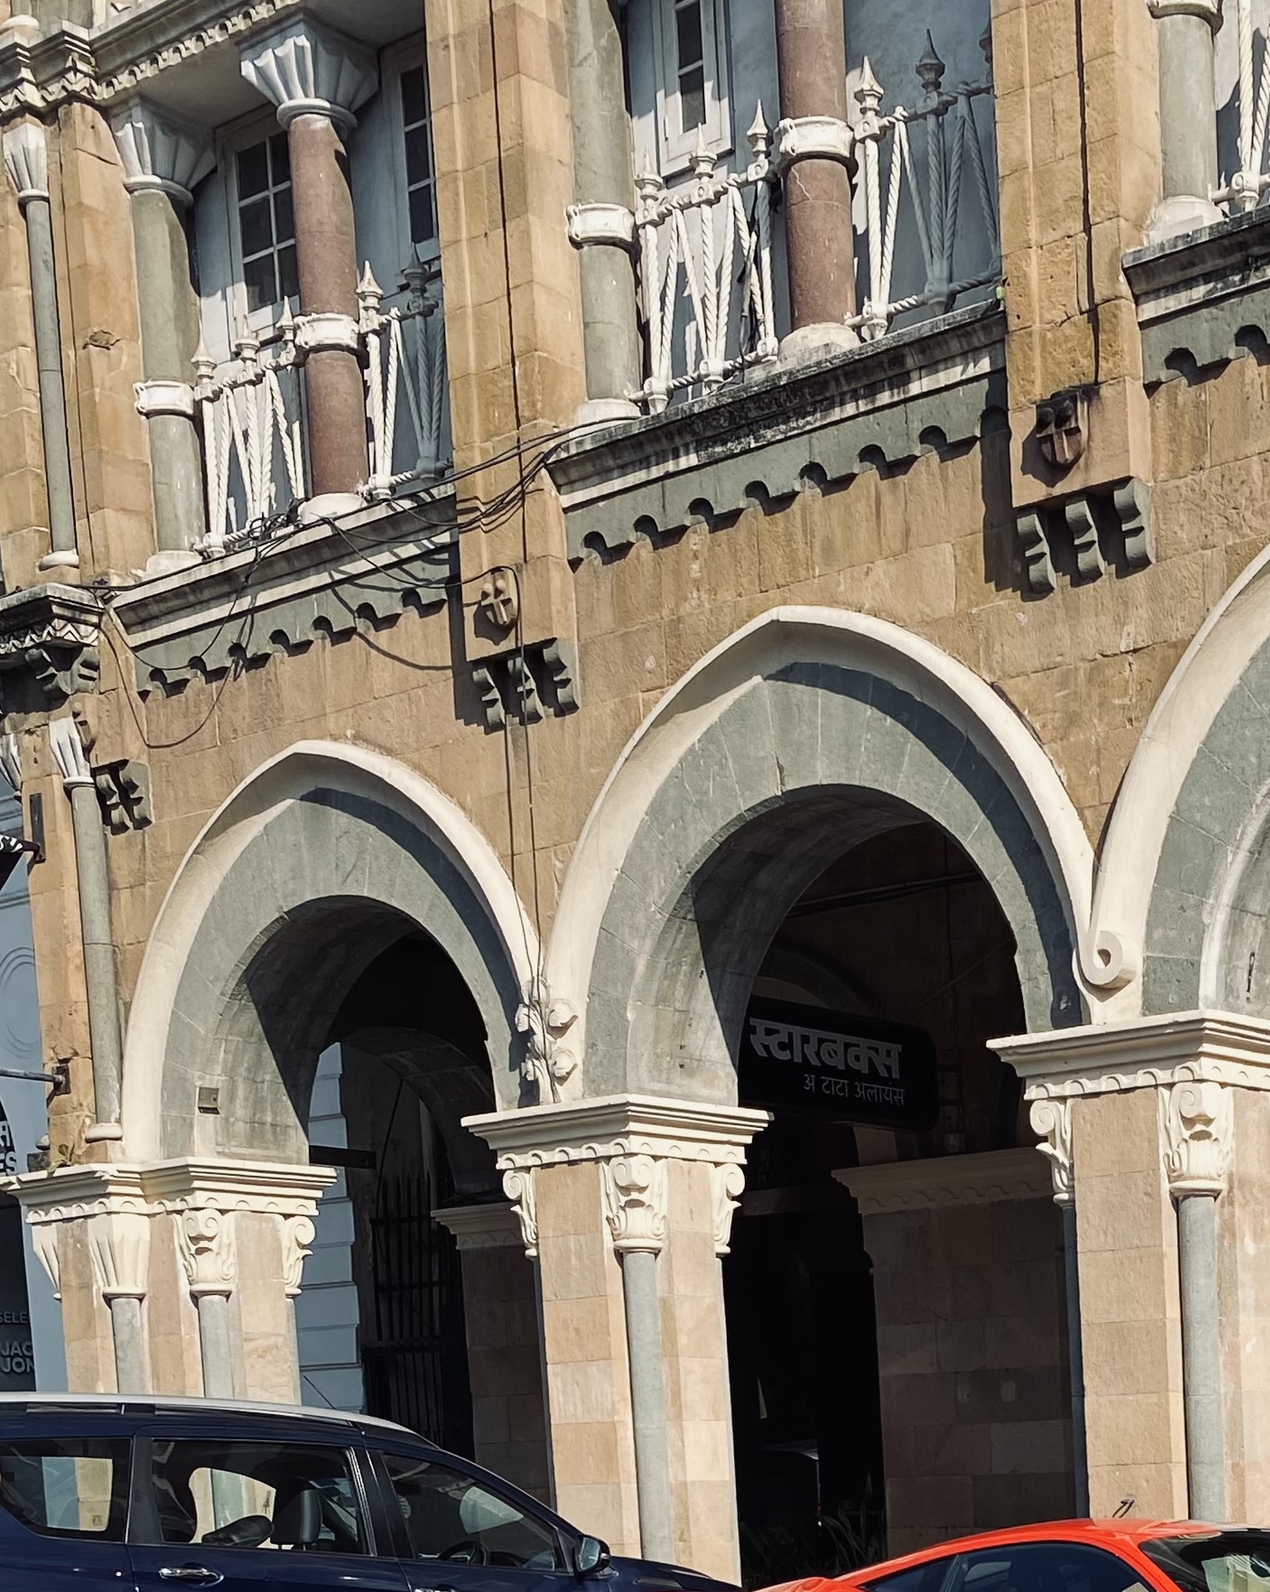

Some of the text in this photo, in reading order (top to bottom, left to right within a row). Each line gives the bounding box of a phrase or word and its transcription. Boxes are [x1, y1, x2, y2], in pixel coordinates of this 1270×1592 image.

[749, 1017, 902, 1079] स्टारबक्स
[803, 1073, 905, 1106] अ टाटा अलायंस
